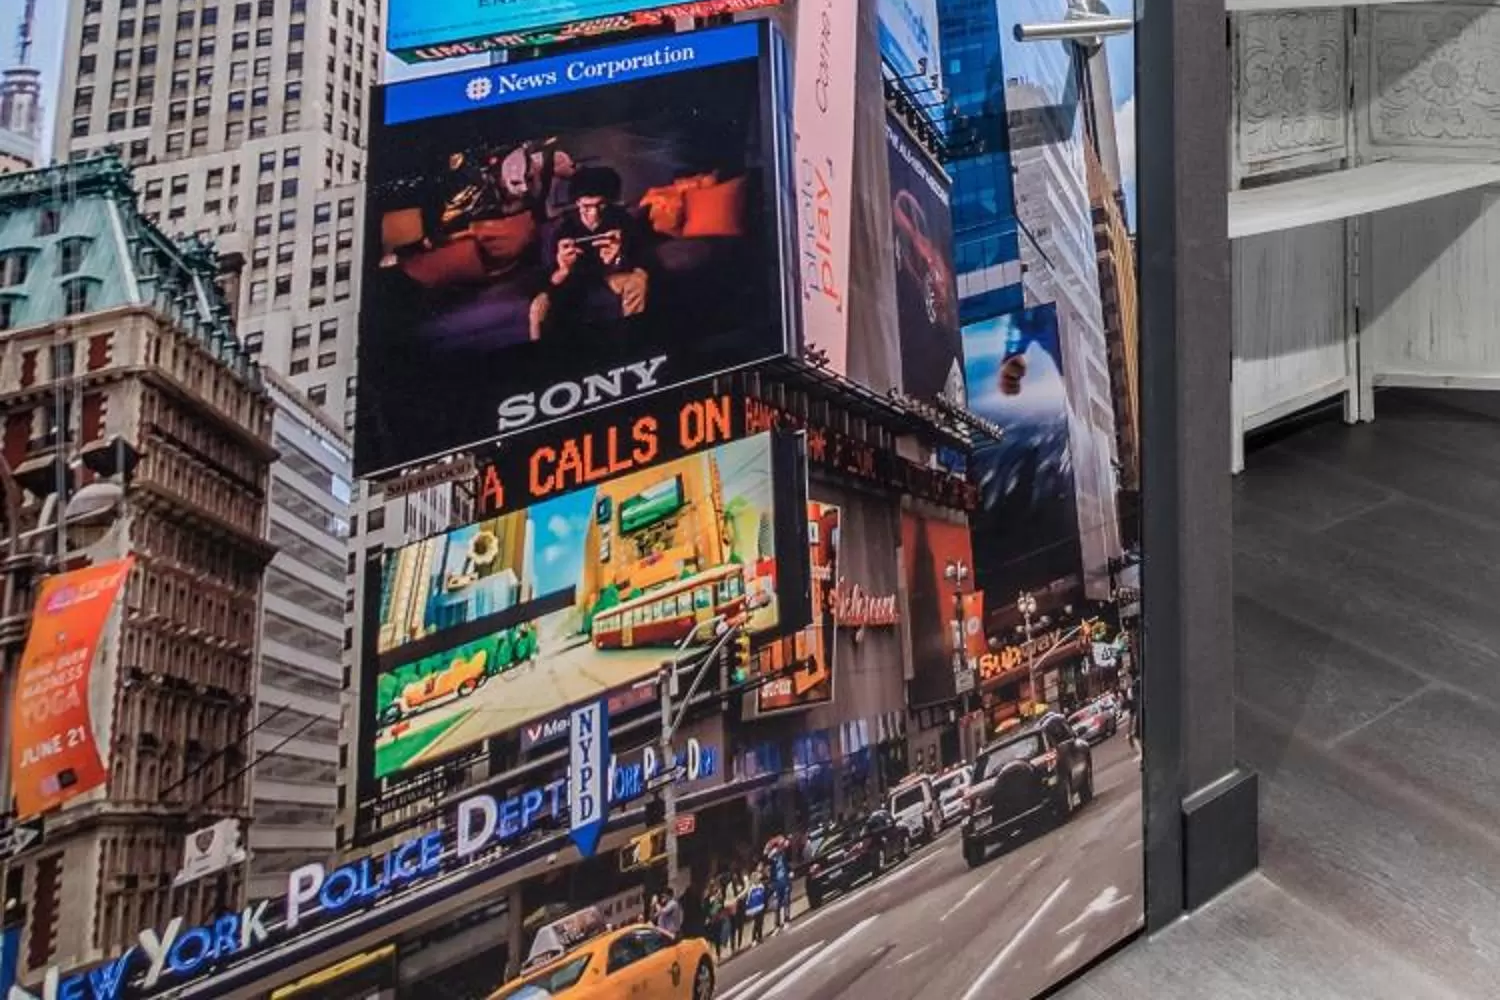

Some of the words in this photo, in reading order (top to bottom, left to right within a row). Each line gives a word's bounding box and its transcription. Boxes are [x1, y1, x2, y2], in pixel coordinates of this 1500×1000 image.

[498, 68, 557, 96] News
[566, 42, 696, 82] Corporation
[498, 355, 667, 430] SONY
[529, 416, 659, 498] CALLS
[678, 396, 732, 450] ON
[19, 733, 63, 769] JUNE
[67, 724, 86, 748] 21
[578, 708, 593, 821] NYPD
[139, 900, 269, 989] YORK
[286, 829, 445, 930] POLICE
